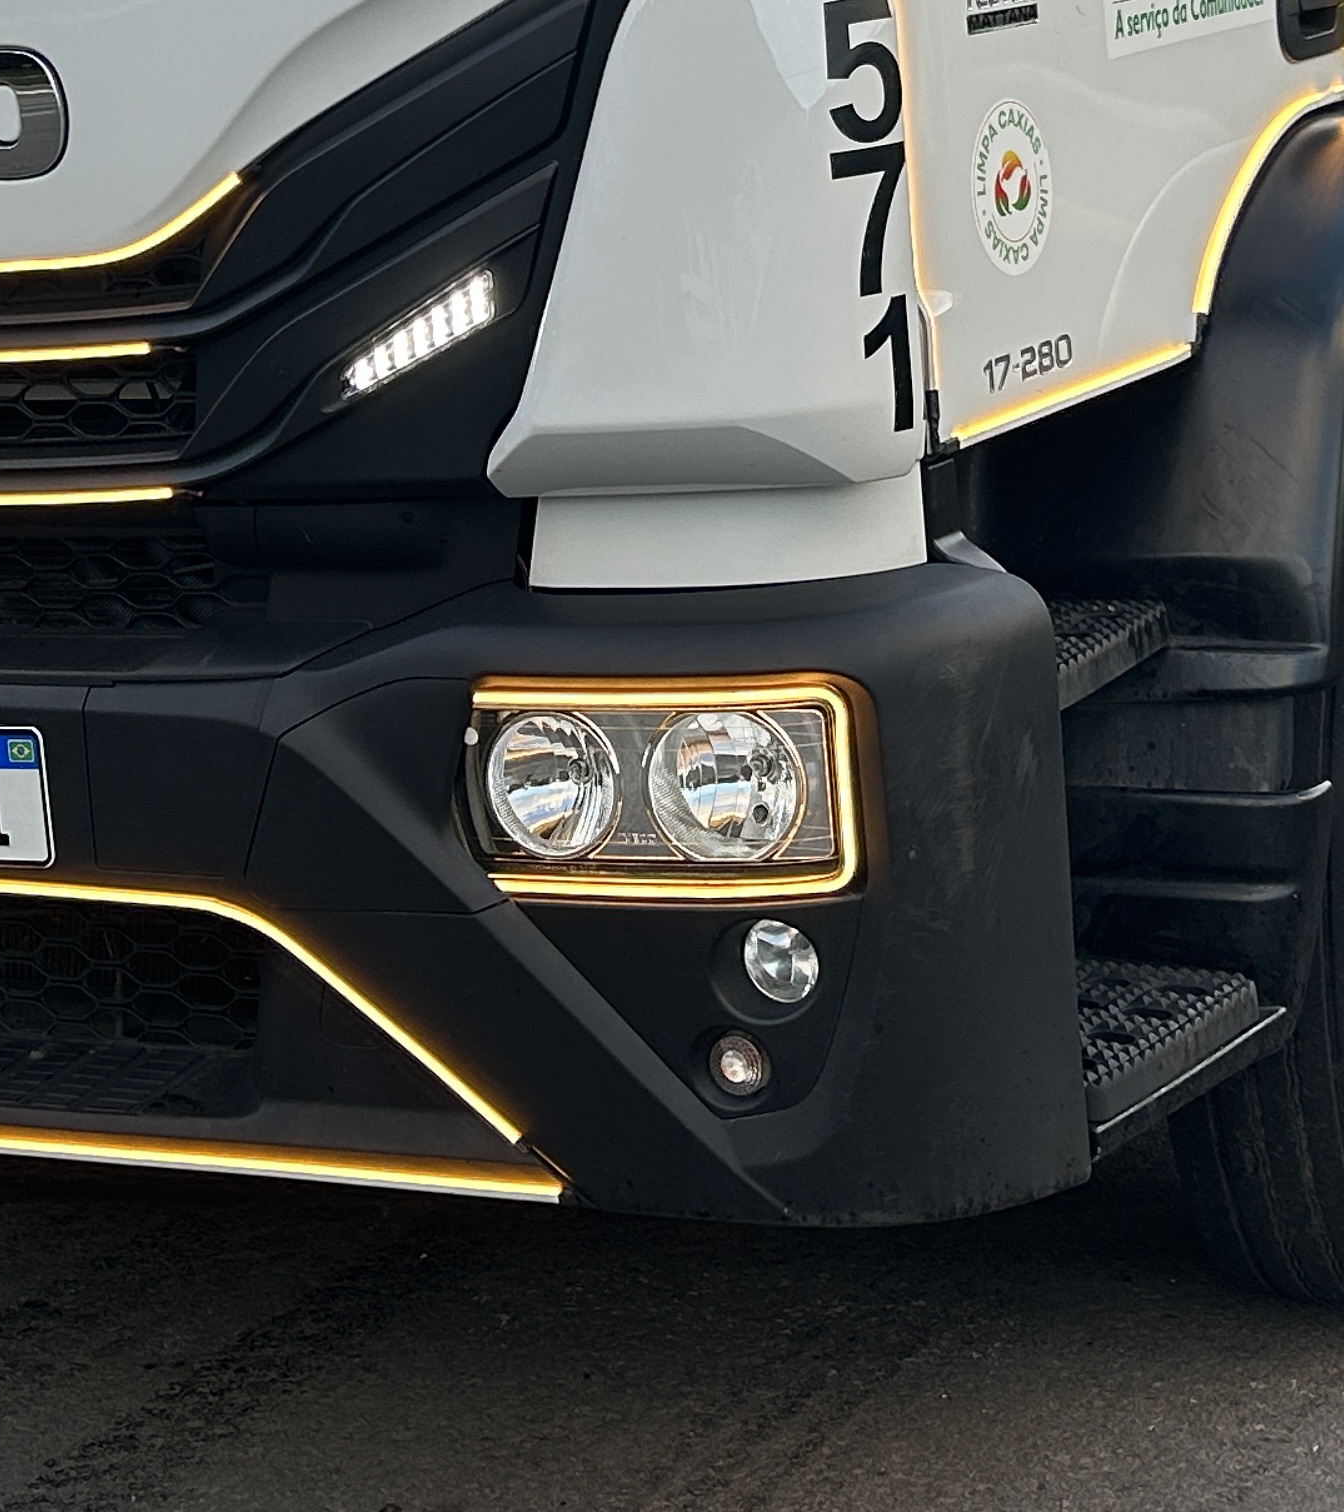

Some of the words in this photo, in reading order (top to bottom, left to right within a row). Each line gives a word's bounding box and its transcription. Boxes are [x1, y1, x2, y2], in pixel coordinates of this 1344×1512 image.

[1115, 9, 1124, 39] A
[1126, 2, 1169, 38] serviço
[976, 124, 998, 197] LIMPA
[997, 108, 1042, 155] CAXIAS
[1029, 173, 1049, 247] LIMPA
[984, 219, 1030, 265] CAXIAS
[983, 333, 1073, 394] 17-280
